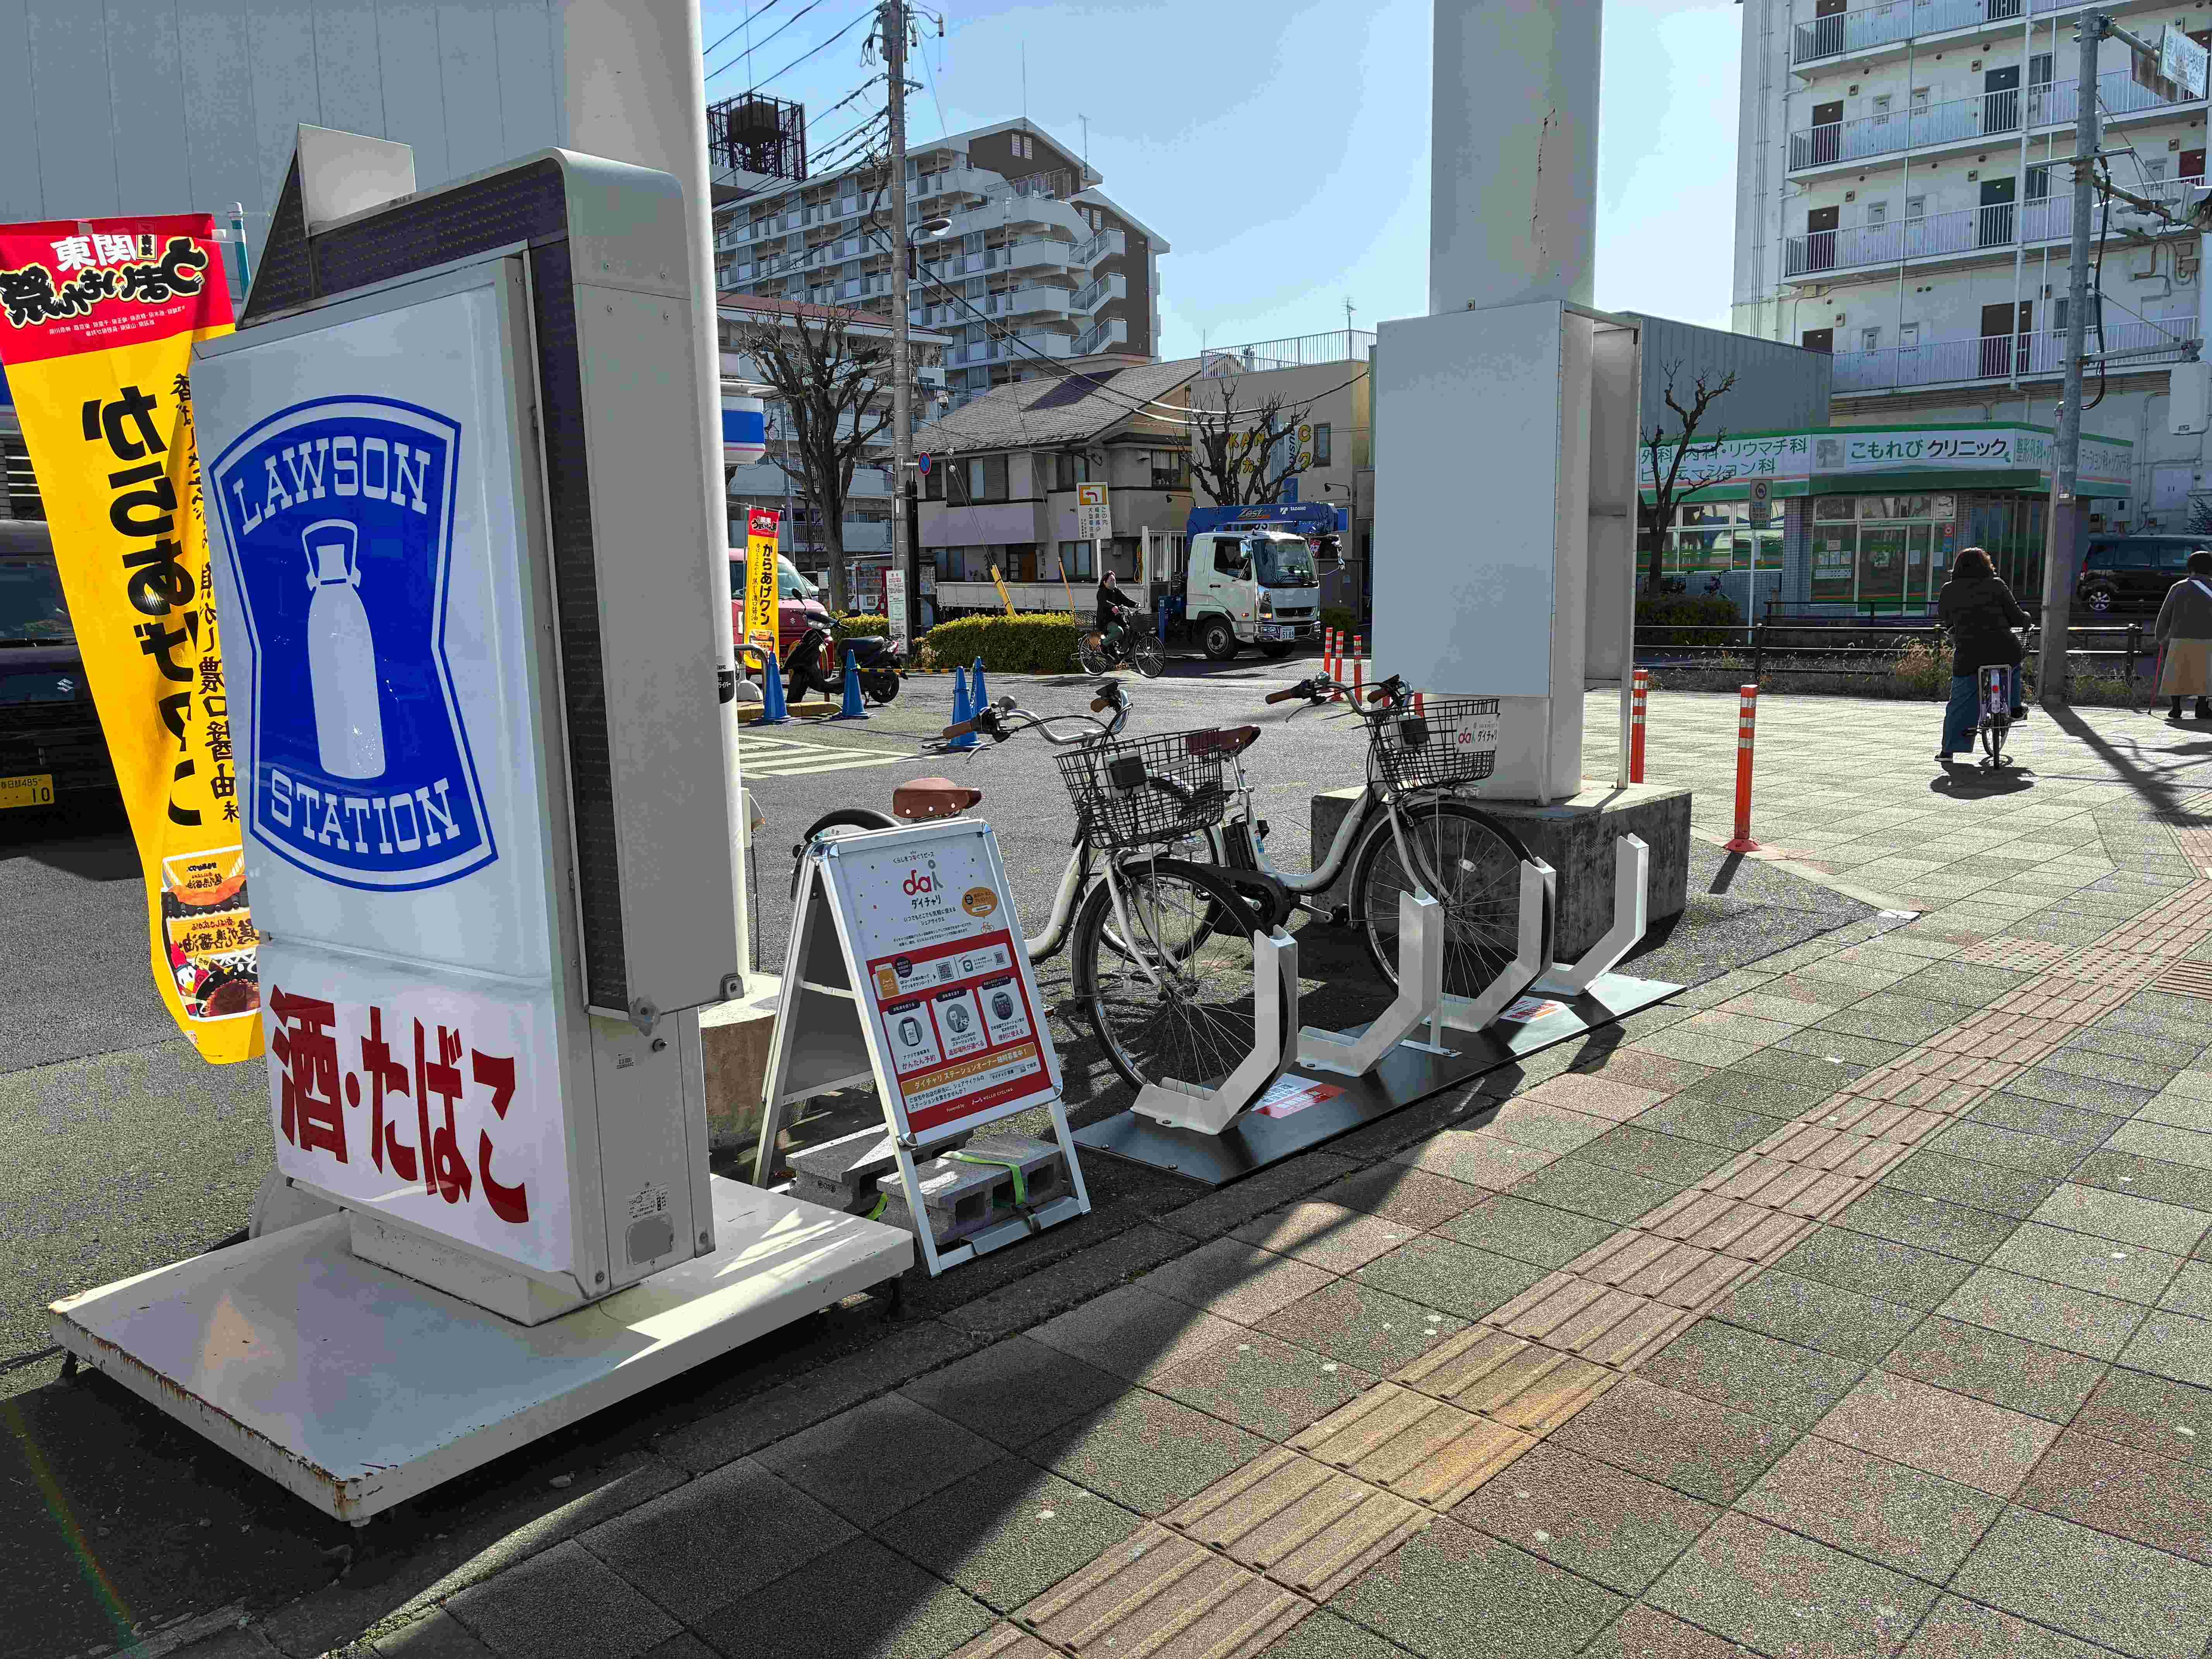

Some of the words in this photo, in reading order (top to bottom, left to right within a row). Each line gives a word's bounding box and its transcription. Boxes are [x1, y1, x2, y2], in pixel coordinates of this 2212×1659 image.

[232, 436, 431, 535] LAWSON
[1851, 438, 1923, 459] こもれび
[1928, 438, 2007, 457] クリニック
[760, 544, 773, 625] からあげクン
[271, 767, 460, 854] STATION
[912, 894, 941, 909] ダイチャリ
[902, 1054, 936, 1069] かんたん予約
[270, 984, 529, 1223] 酒・たばこ
